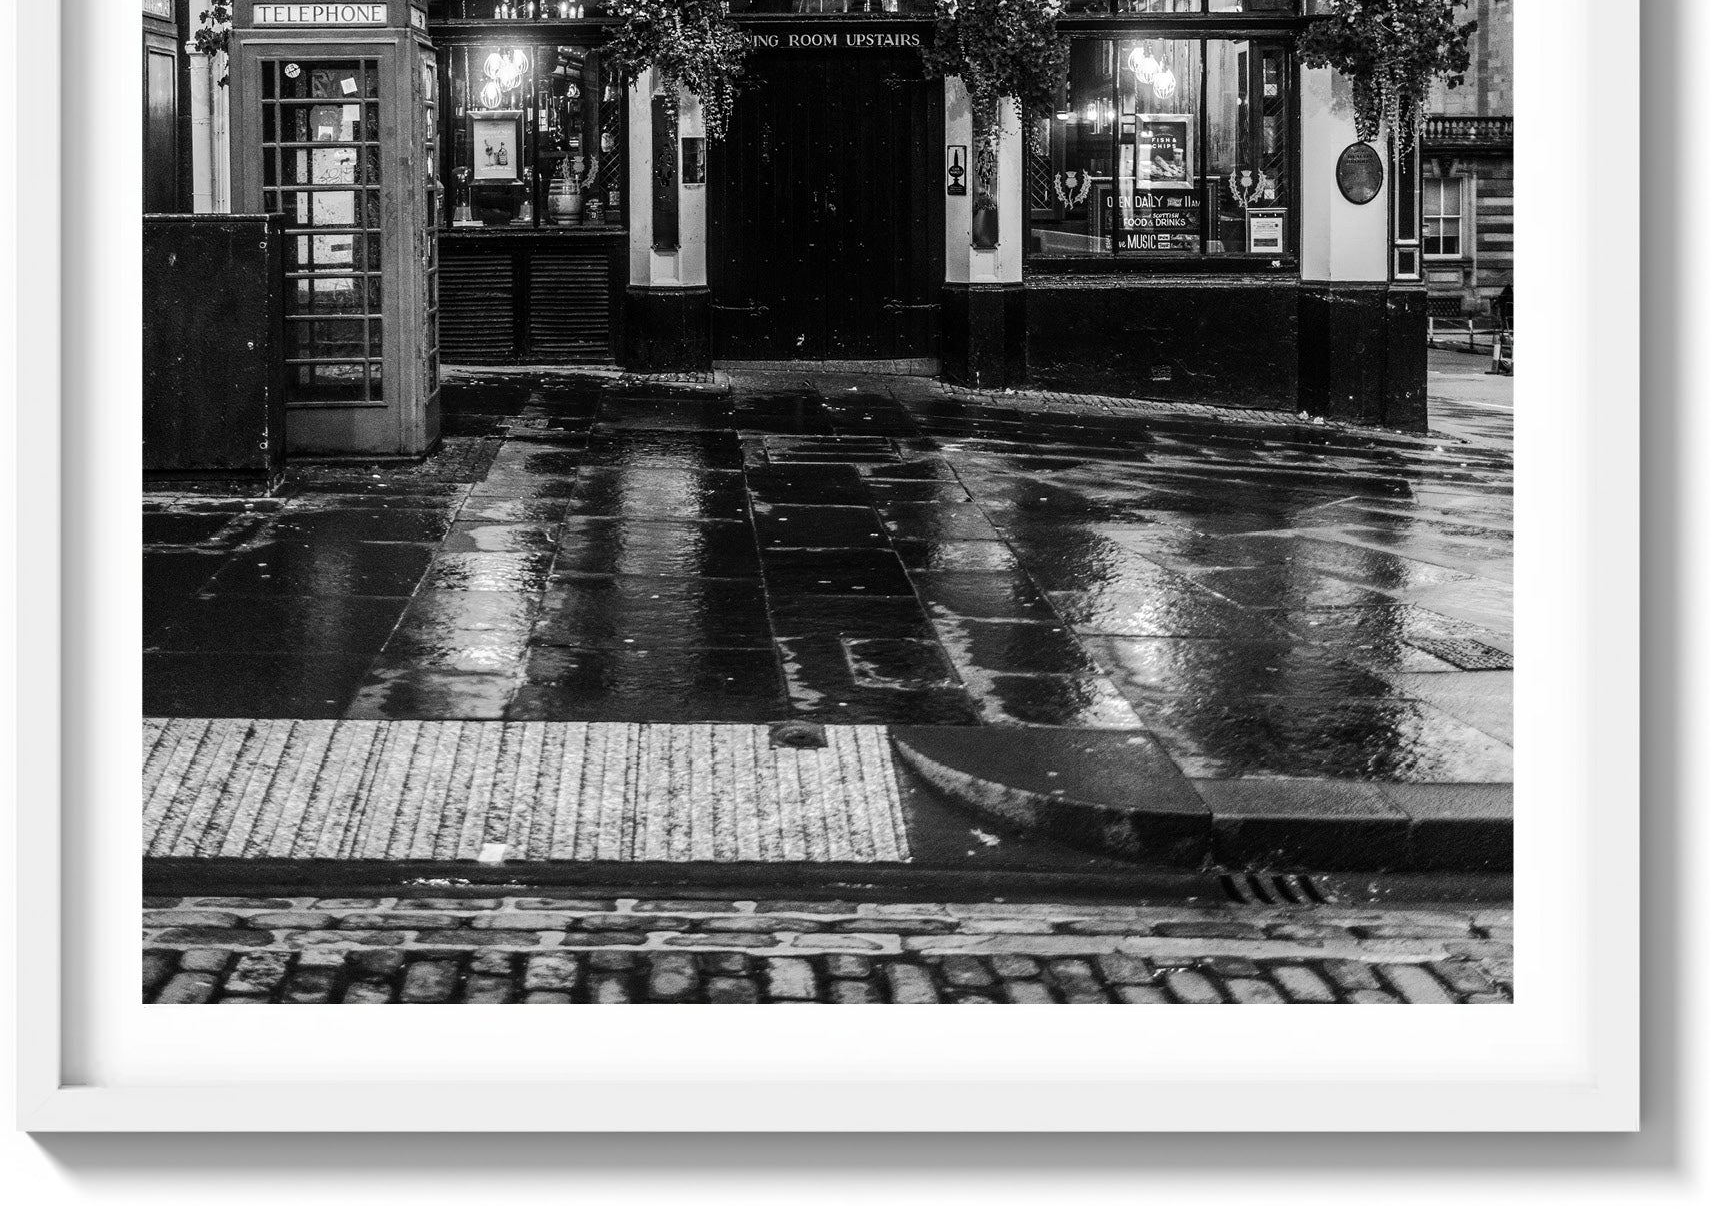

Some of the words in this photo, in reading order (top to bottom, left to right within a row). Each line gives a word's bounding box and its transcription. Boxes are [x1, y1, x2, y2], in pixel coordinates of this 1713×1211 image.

[258, 5, 382, 23] TELEPHONE
[749, 34, 779, 47] ING
[788, 34, 838, 47] ROOM
[846, 33, 920, 47] UPSTAIRS
[1106, 195, 1131, 208] OEN
[1135, 195, 1164, 208] DAILY
[1123, 218, 1148, 227] FOOD
[1155, 217, 1186, 227] DRINKS
[1127, 233, 1157, 250] MUSIC
